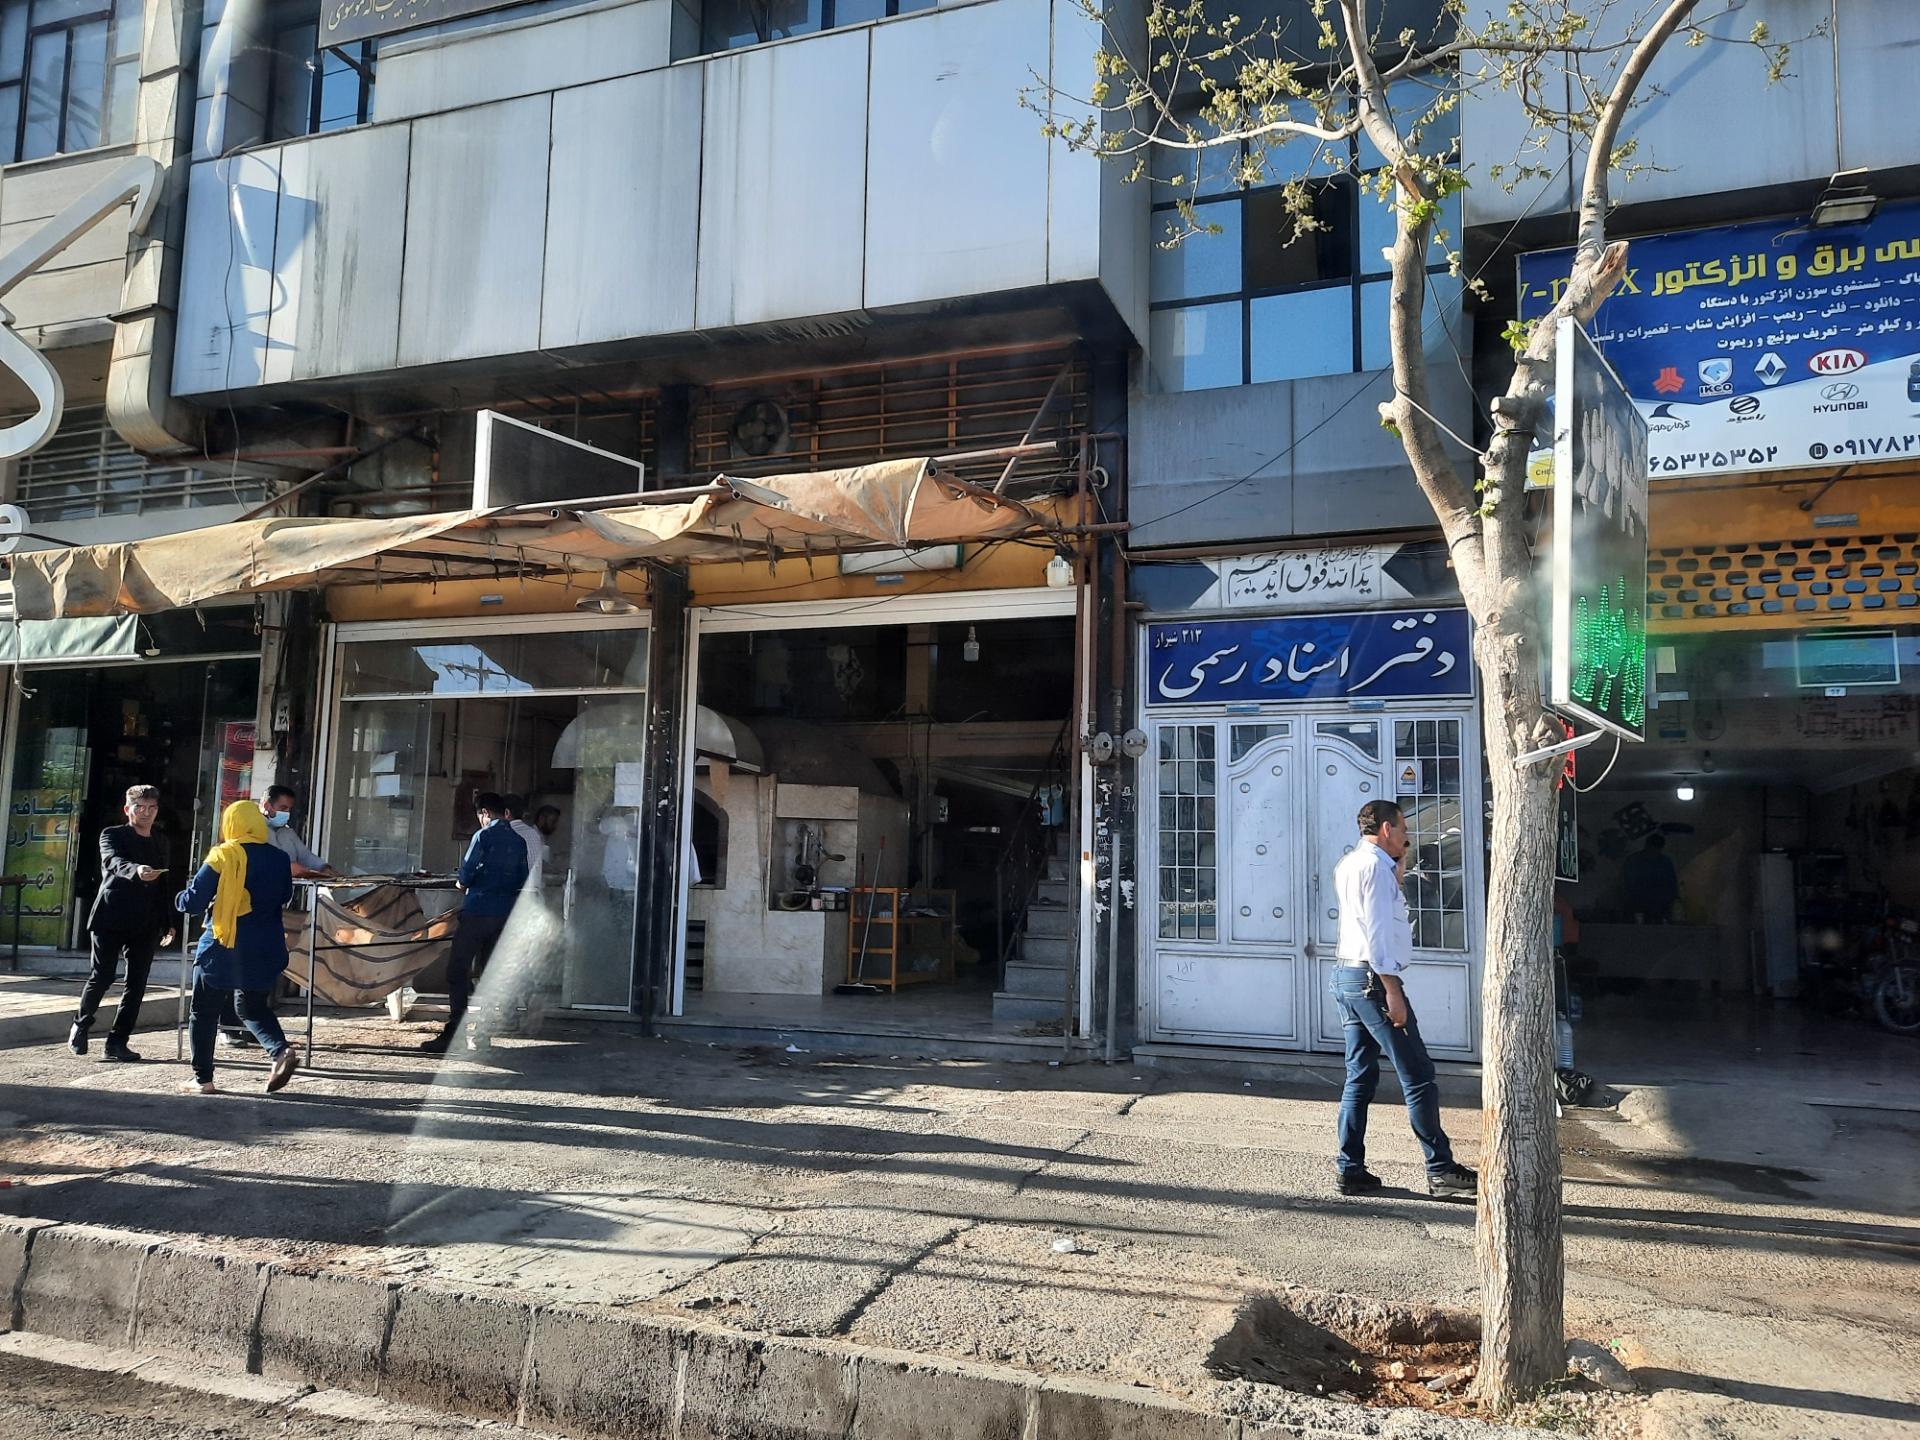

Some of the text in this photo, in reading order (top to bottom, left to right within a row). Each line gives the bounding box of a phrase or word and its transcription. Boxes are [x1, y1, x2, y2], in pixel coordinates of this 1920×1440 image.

[1776, 254, 1797, 281] و
[1806, 244, 1866, 277] برق
[1651, 253, 1766, 297] انژکتور
[1795, 287, 1828, 301] سوزن
[1831, 277, 1881, 297] شستشوی
[1740, 293, 1749, 306] با
[1752, 288, 1793, 306] انژکتور
[1864, 296, 1901, 313] دانلود
[1772, 310, 1804, 324] ریمپ
[1821, 301, 1847, 318] فلش
[1685, 317, 1713, 333] شتاب
[1716, 312, 1756, 330] افزایش
[1855, 322, 1874, 337] متر
[1877, 317, 1902, 334] کیلو
[1904, 320, 1913, 331] و
[1617, 332, 1624, 342] و
[1626, 323, 1669, 340] تعمیرات
[1766, 329, 1800, 345] سوئیچ
[1802, 325, 1838, 341] تعریف
[1717, 337, 1754, 351] ریموت
[1756, 337, 1764, 348] و
[1817, 353, 1858, 371] KIA
[1700, 384, 1732, 394] IKCO
[1813, 401, 1868, 413] HYUNDAI
[1154, 630, 1178, 649] شیراز
[1158, 612, 1456, 699] دفتر اسناد رسمی
[14, 866, 55, 891] قهو
